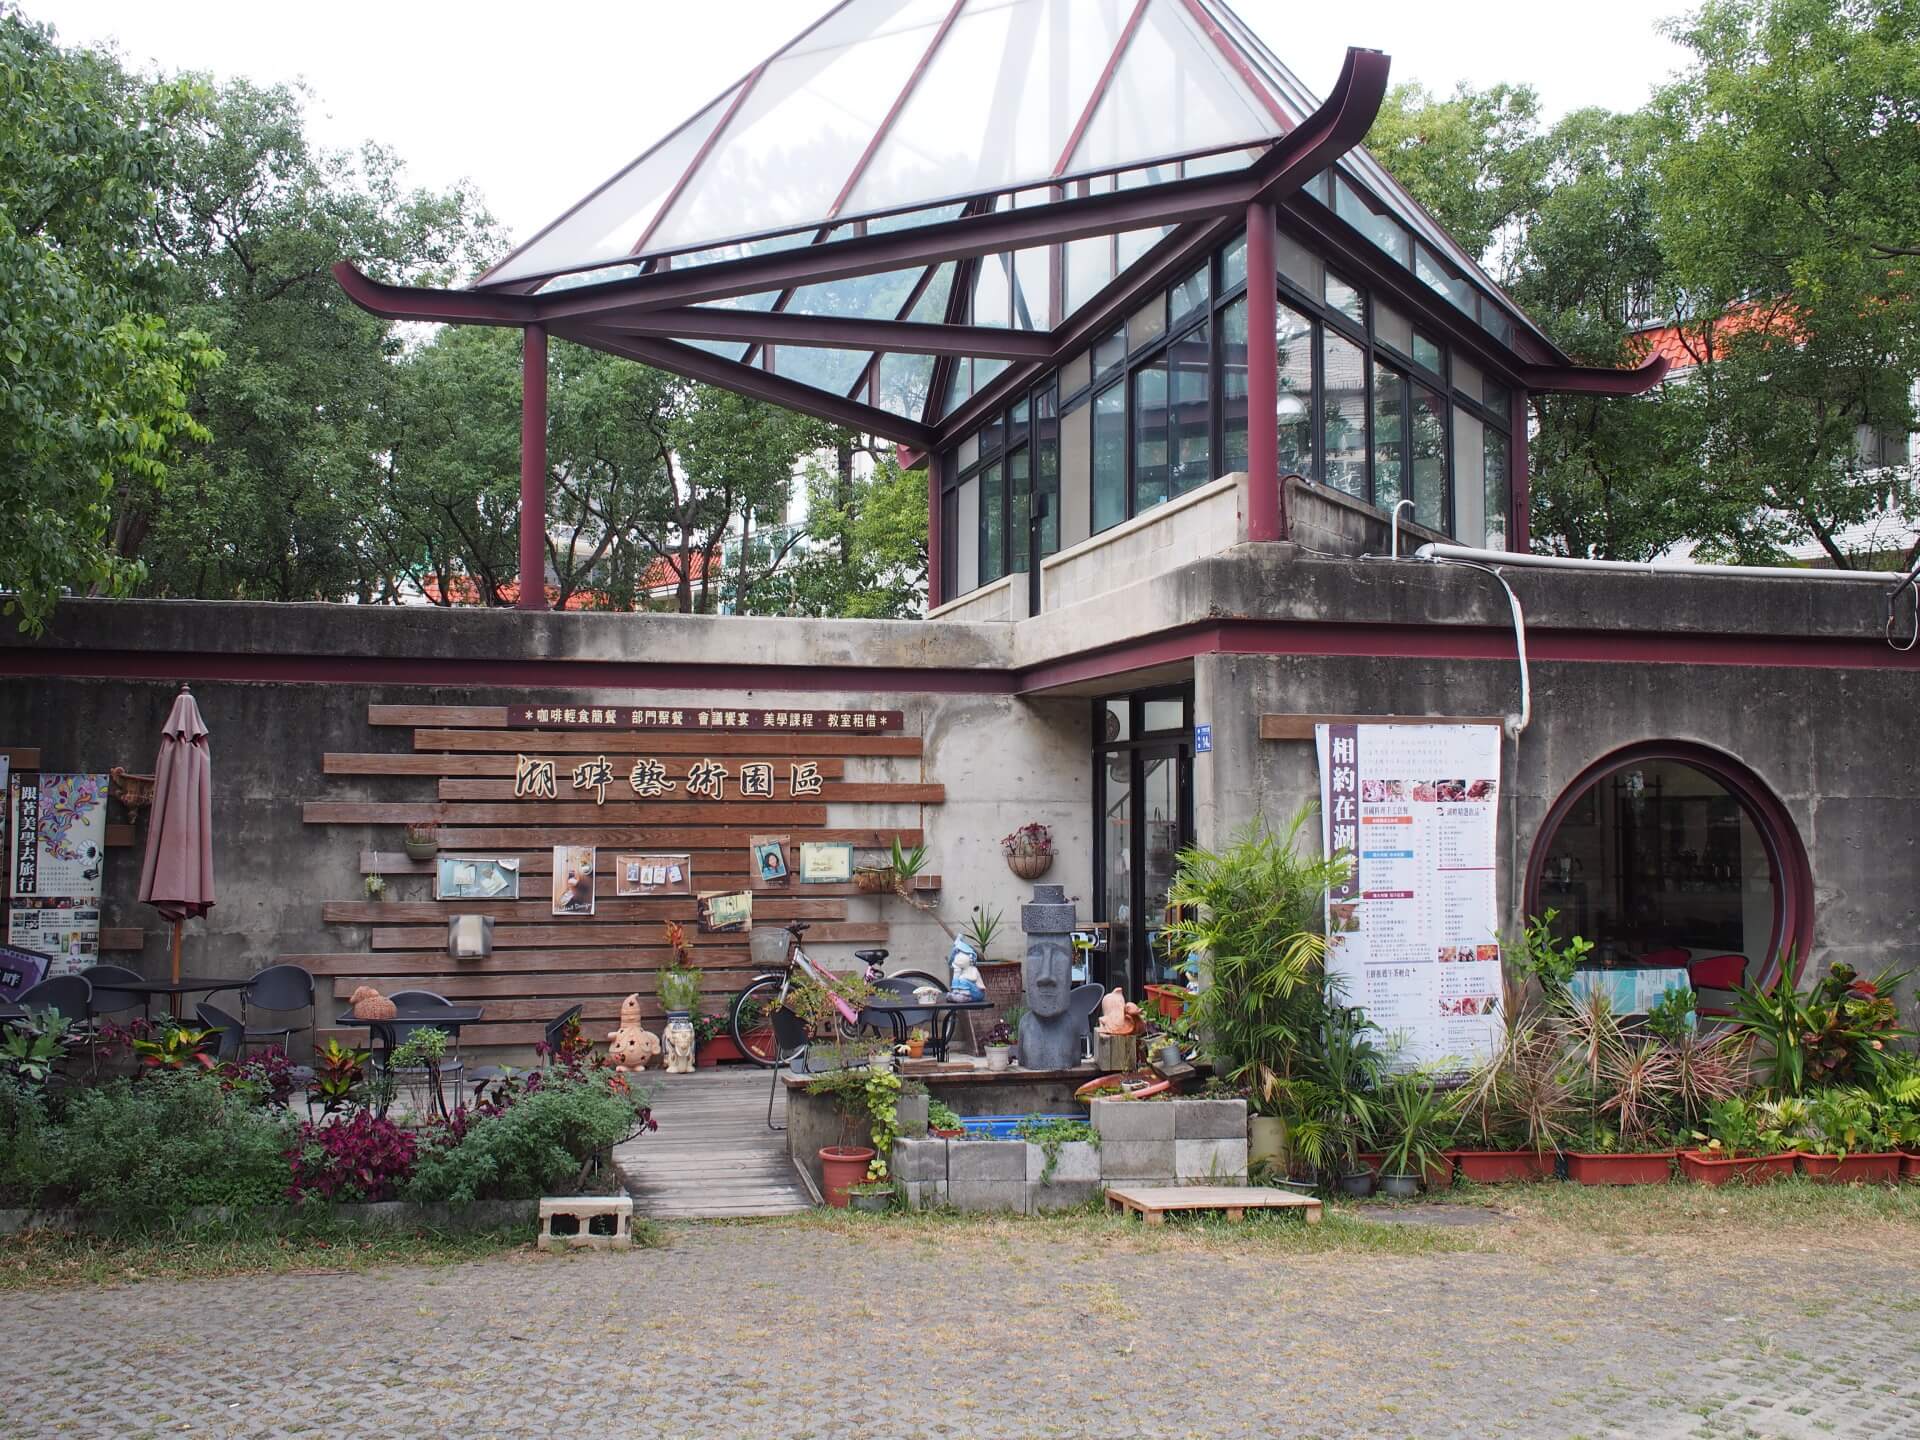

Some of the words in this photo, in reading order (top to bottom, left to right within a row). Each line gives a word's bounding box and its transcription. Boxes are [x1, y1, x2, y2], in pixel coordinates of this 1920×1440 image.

[537, 709, 617, 725] 咖啡輕食簡餐
[632, 710, 684, 726] 部門聚餐
[698, 711, 750, 727] 會議饗宴
[763, 712, 814, 728] 美學課程
[828, 713, 877, 728] 教室租借
[515, 754, 824, 805] 湖畔藝術園區
[18, 786, 38, 892] 跟著美學去旅行
